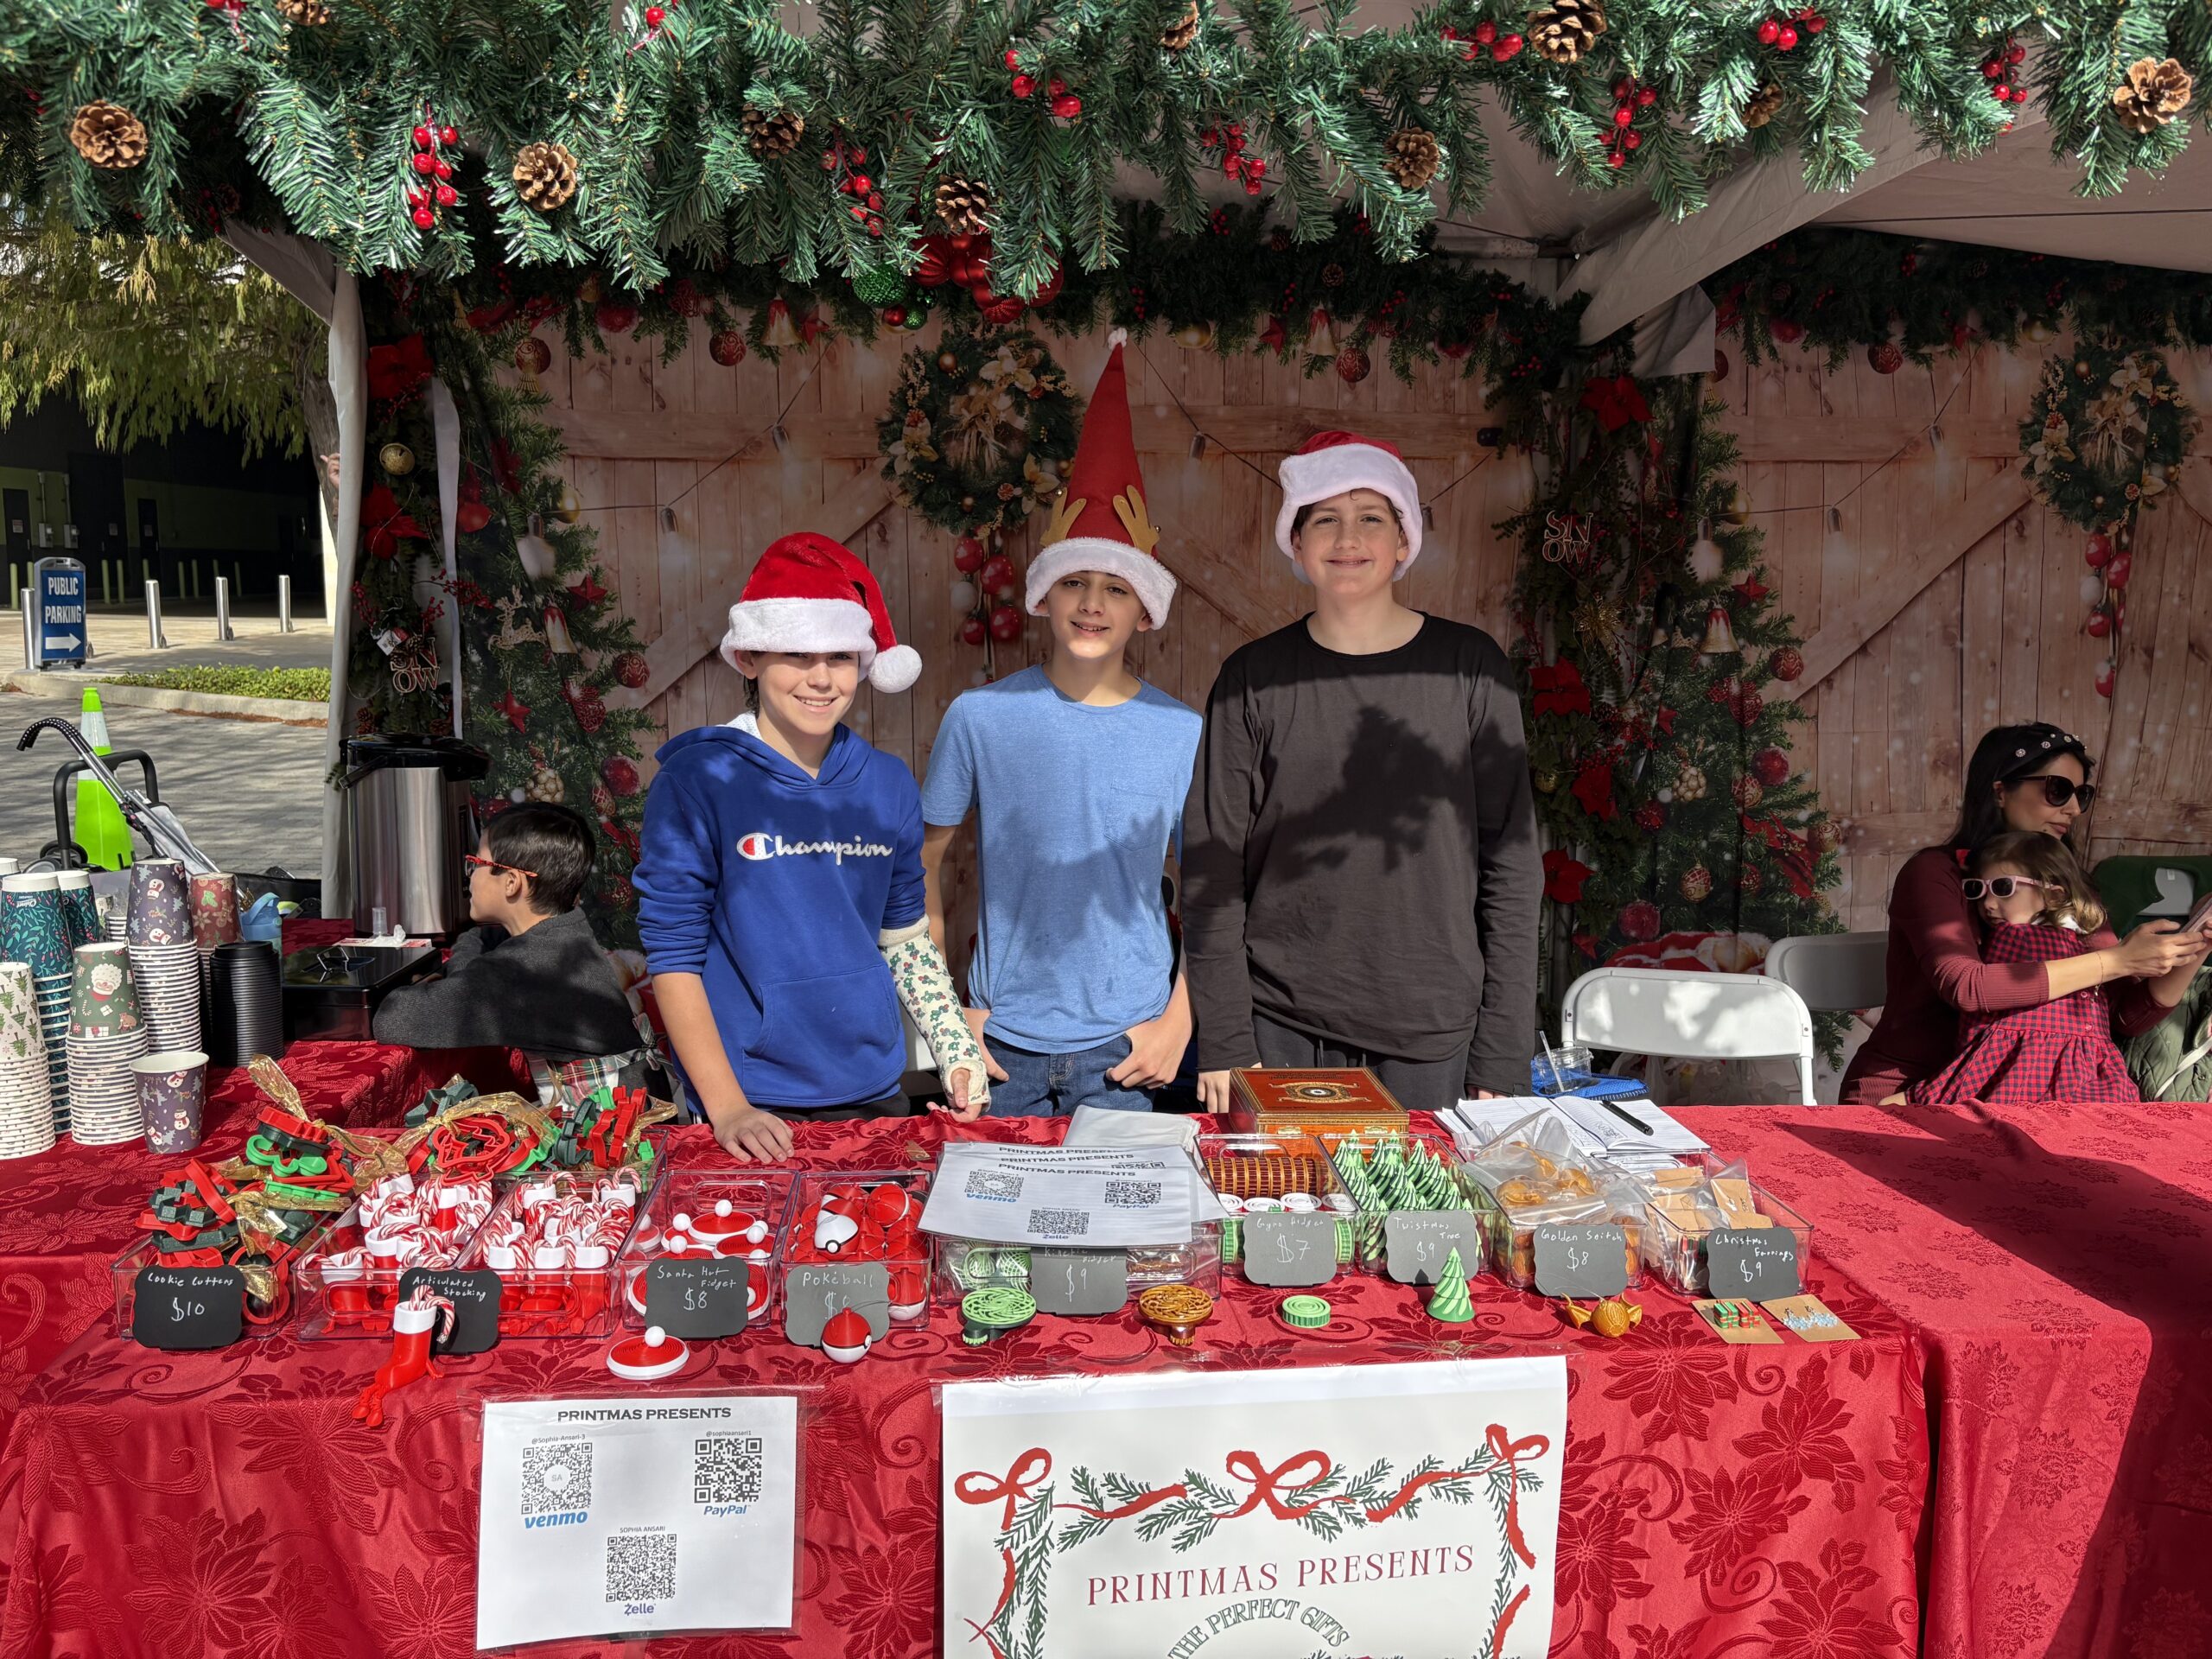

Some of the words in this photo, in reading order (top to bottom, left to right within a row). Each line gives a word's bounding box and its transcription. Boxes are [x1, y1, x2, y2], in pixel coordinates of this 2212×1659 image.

[48, 576, 79, 595] PUBLIC
[45, 606, 82, 624] PARKING
[737, 832, 893, 866] Champion
[998, 1163, 1065, 1174] PRINTMAS
[966, 1192, 1017, 1203] venmo
[1541, 1228, 1579, 1243] Golden
[1715, 1234, 1768, 1245] Christmas
[1276, 1232, 1311, 1263] $7
[1416, 1241, 1434, 1262] $9
[1567, 1246, 1589, 1272] $8
[148, 1273, 184, 1287] Cookie
[1739, 1259, 1762, 1283] $9
[413, 1275, 474, 1287] Articulated
[1065, 1264, 1087, 1302] $9
[443, 1287, 486, 1303] Stocking
[683, 1287, 708, 1311] $8
[171, 1297, 205, 1322] $10
[557, 1409, 643, 1421] PRINTMAS
[645, 1408, 732, 1420] PRESENTS
[550, 1473, 563, 1482] SA
[524, 1510, 588, 1529] venmo
[703, 1504, 747, 1517] PayPal
[1087, 1562, 1278, 1605] PRINTMAS
[1298, 1544, 1473, 1587] PRESENTS
[624, 1603, 655, 1616] Zelle
[1167, 1624, 1210, 1659] THE
[1205, 1598, 1300, 1635] PERFECT
[1300, 1605, 1350, 1648] GIFTS
